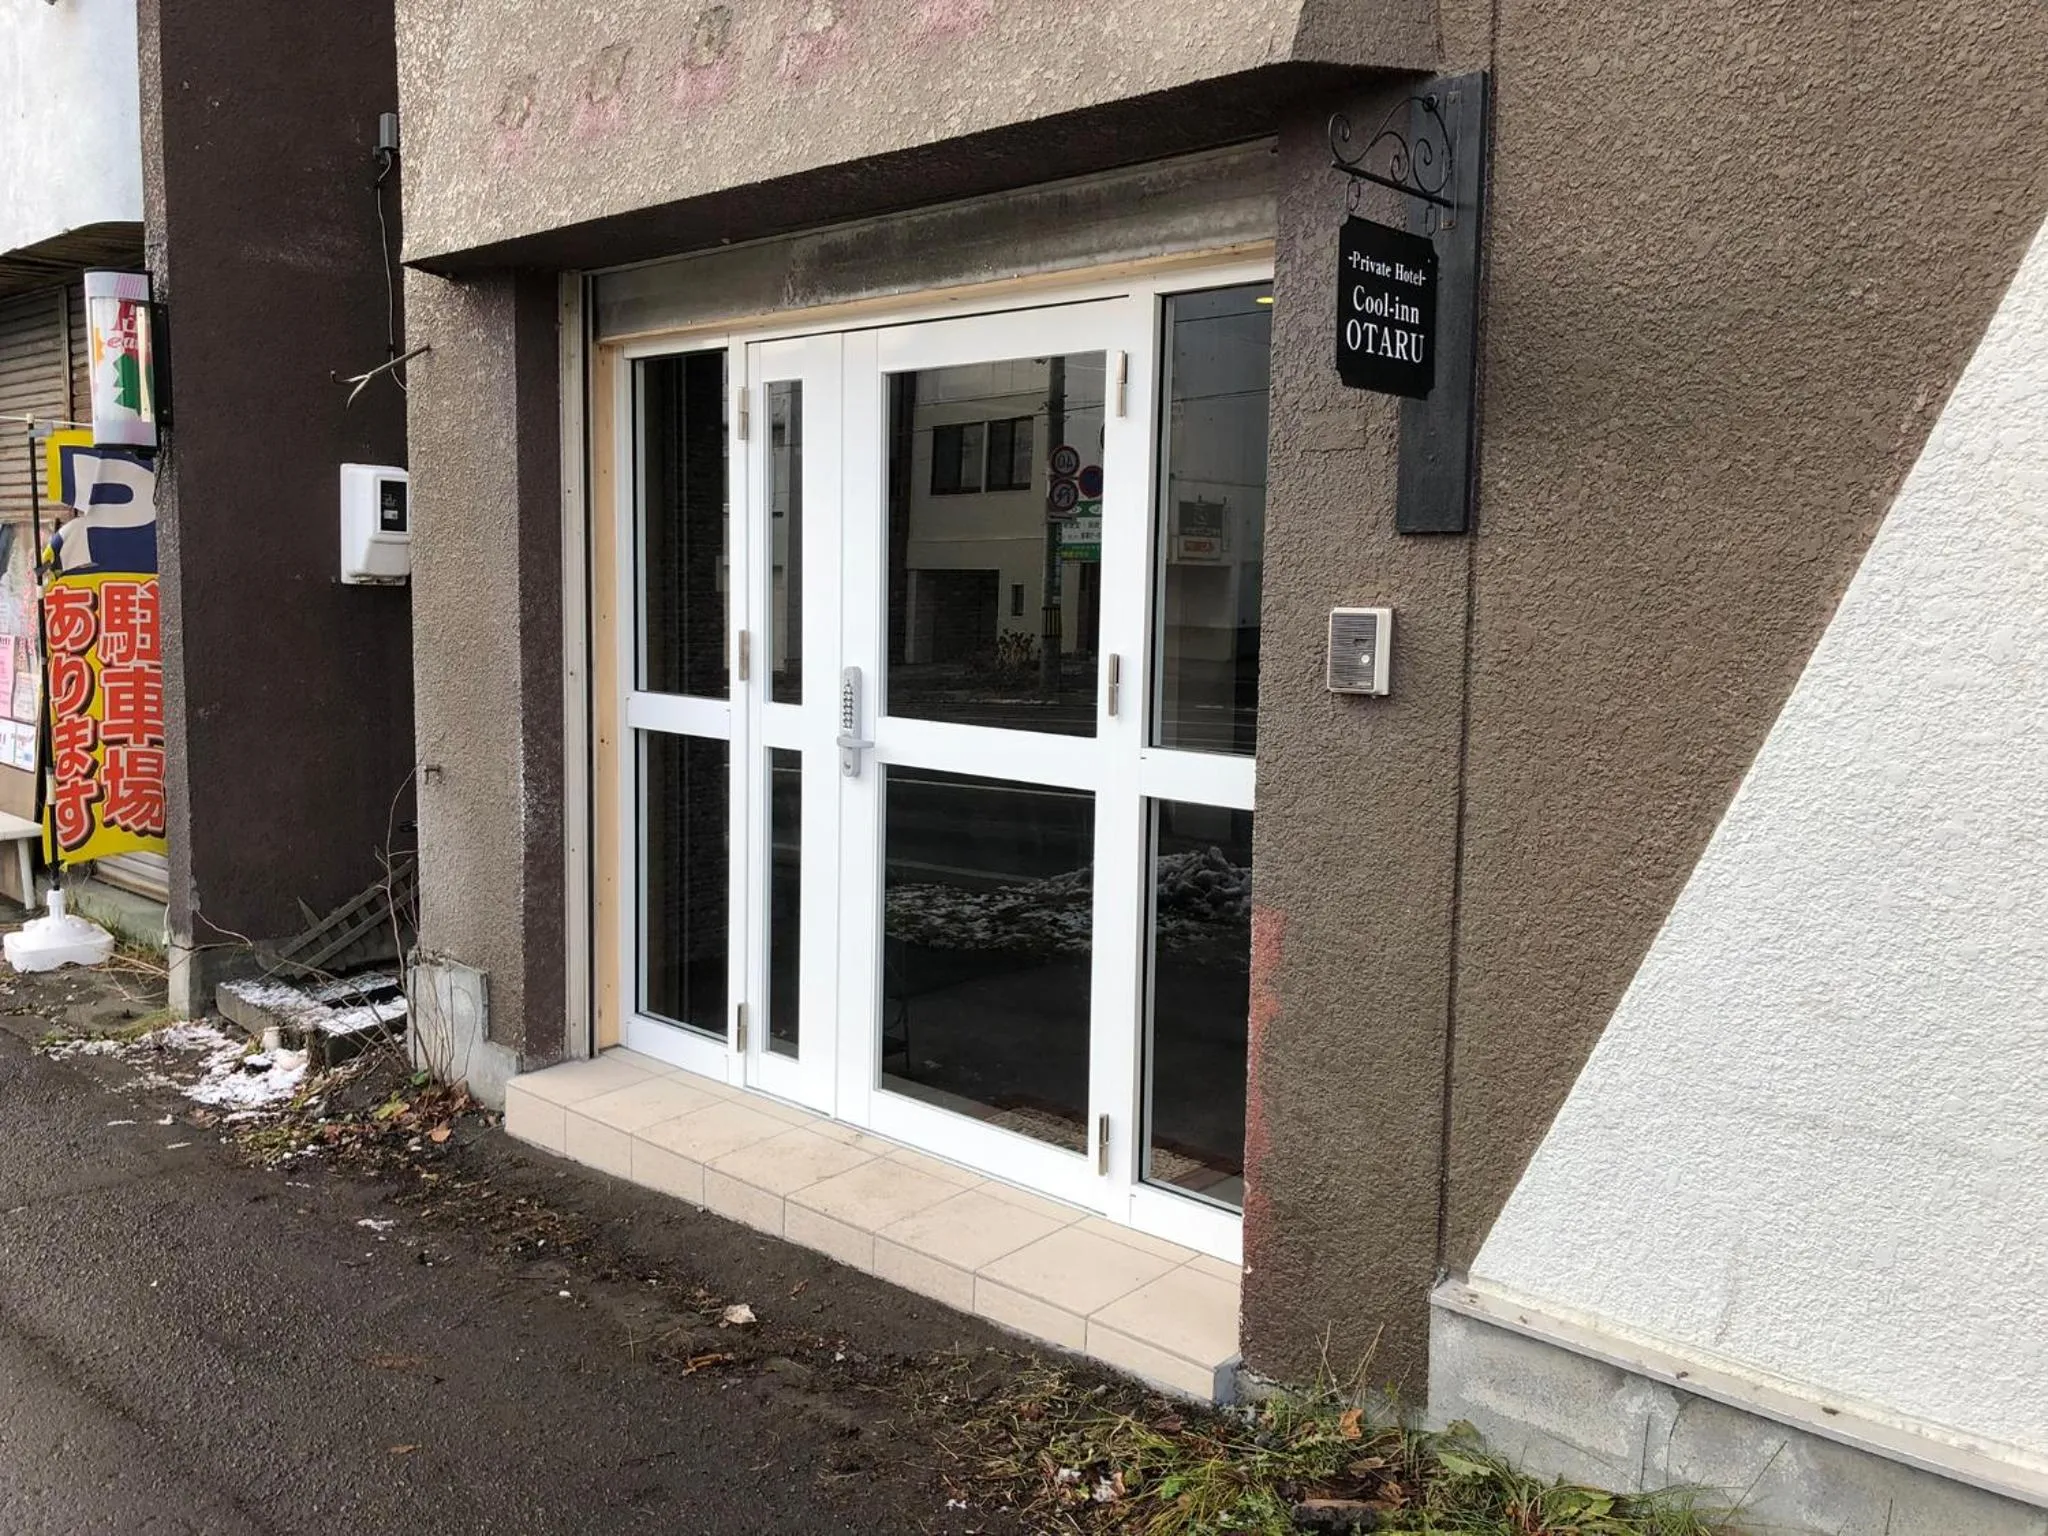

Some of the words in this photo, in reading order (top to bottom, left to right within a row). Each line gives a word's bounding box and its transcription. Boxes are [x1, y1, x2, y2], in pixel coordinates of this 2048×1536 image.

[1346, 319, 1425, 363] OTARU
[1353, 285, 1420, 324] Cool-inn
[59, 454, 157, 572] P
[45, 585, 98, 849] あります
[100, 579, 167, 836] 駐車場
